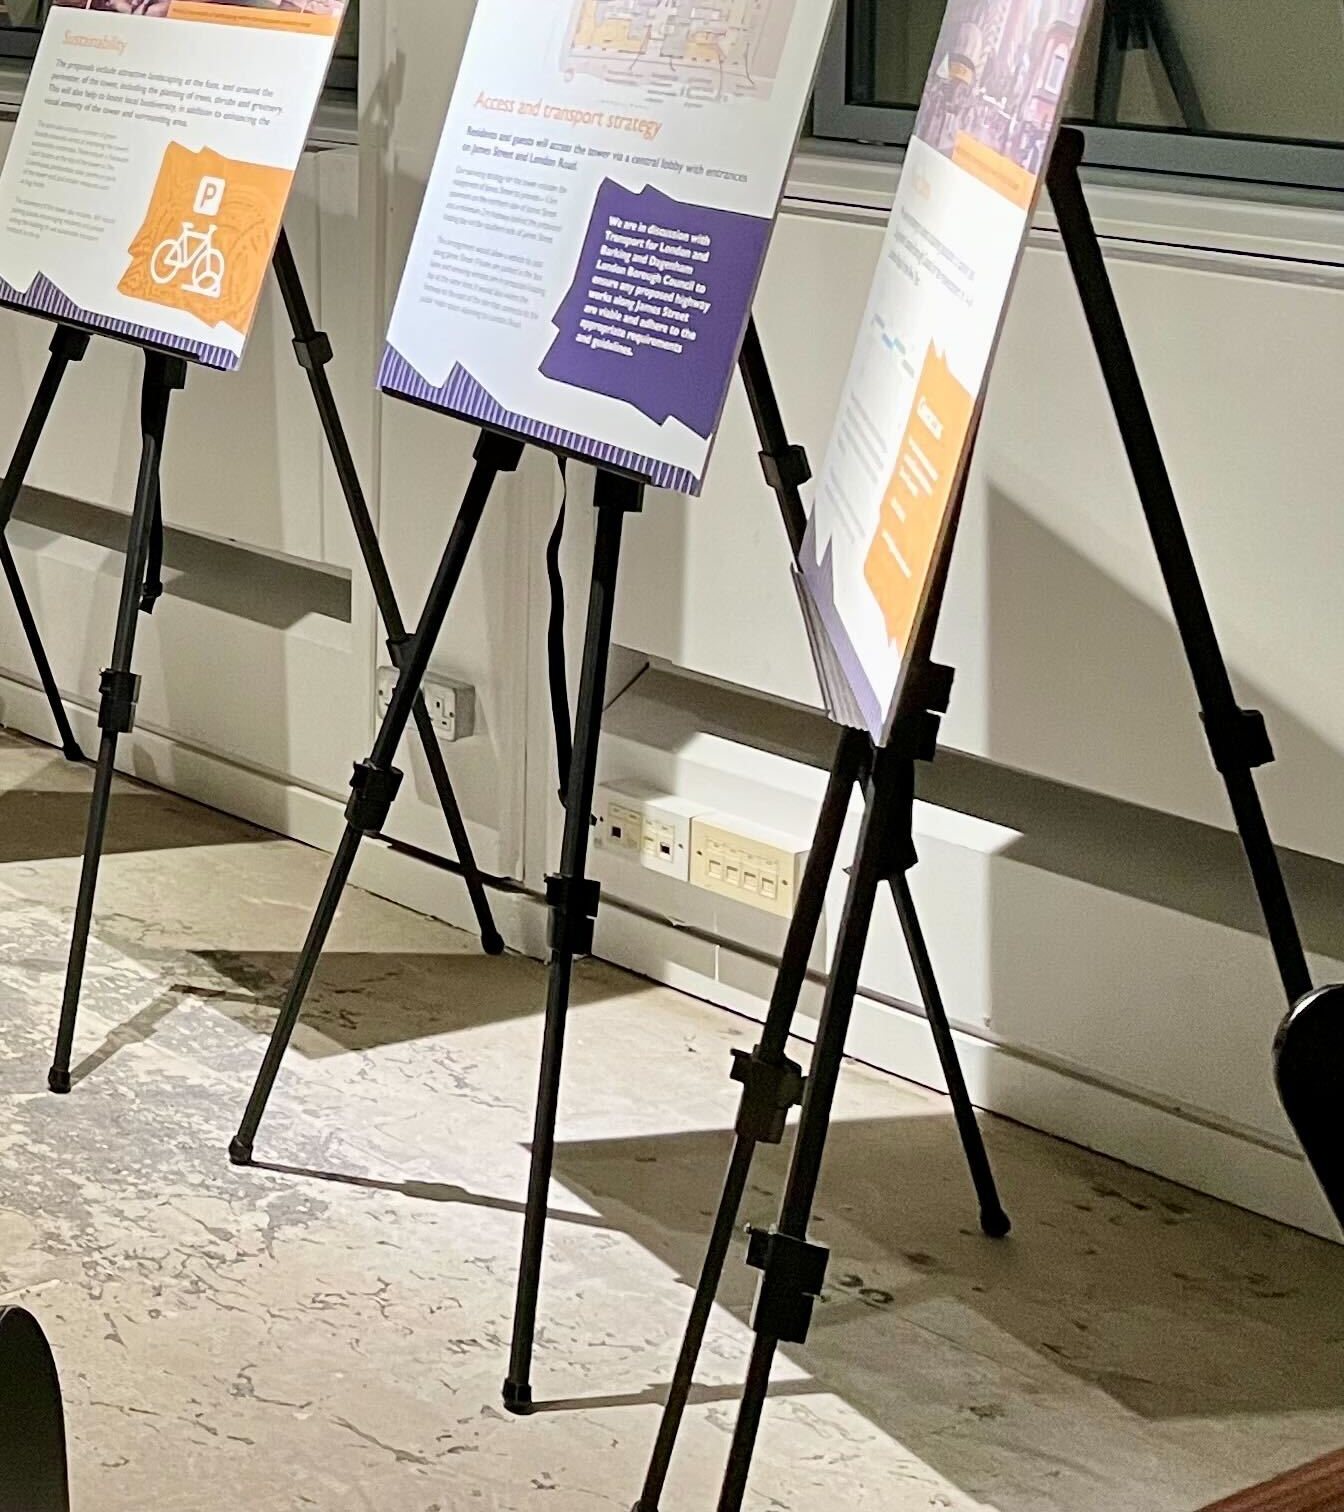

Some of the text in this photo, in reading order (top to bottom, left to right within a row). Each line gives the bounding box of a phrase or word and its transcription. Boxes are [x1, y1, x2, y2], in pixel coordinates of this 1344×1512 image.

[474, 91, 662, 140] Access and transport strategy
[200, 183, 217, 208] P
[606, 230, 710, 262] Transport for London and
[609, 216, 622, 228] We
[623, 219, 636, 231] are
[638, 222, 647, 233] in
[690, 234, 710, 246] with
[600, 244, 694, 275] Barking and Dagenham
[595, 259, 706, 294] London Borough Council to
[588, 290, 690, 322] works along James Street
[635, 285, 675, 303] proposed
[675, 293, 711, 314] highway
[576, 333, 592, 344] and
[598, 308, 622, 322] viable
[623, 315, 640, 326] and
[640, 318, 670, 334] adhere
[670, 325, 680, 336] to
[680, 328, 697, 340] the
[626, 331, 682, 354] requirements
